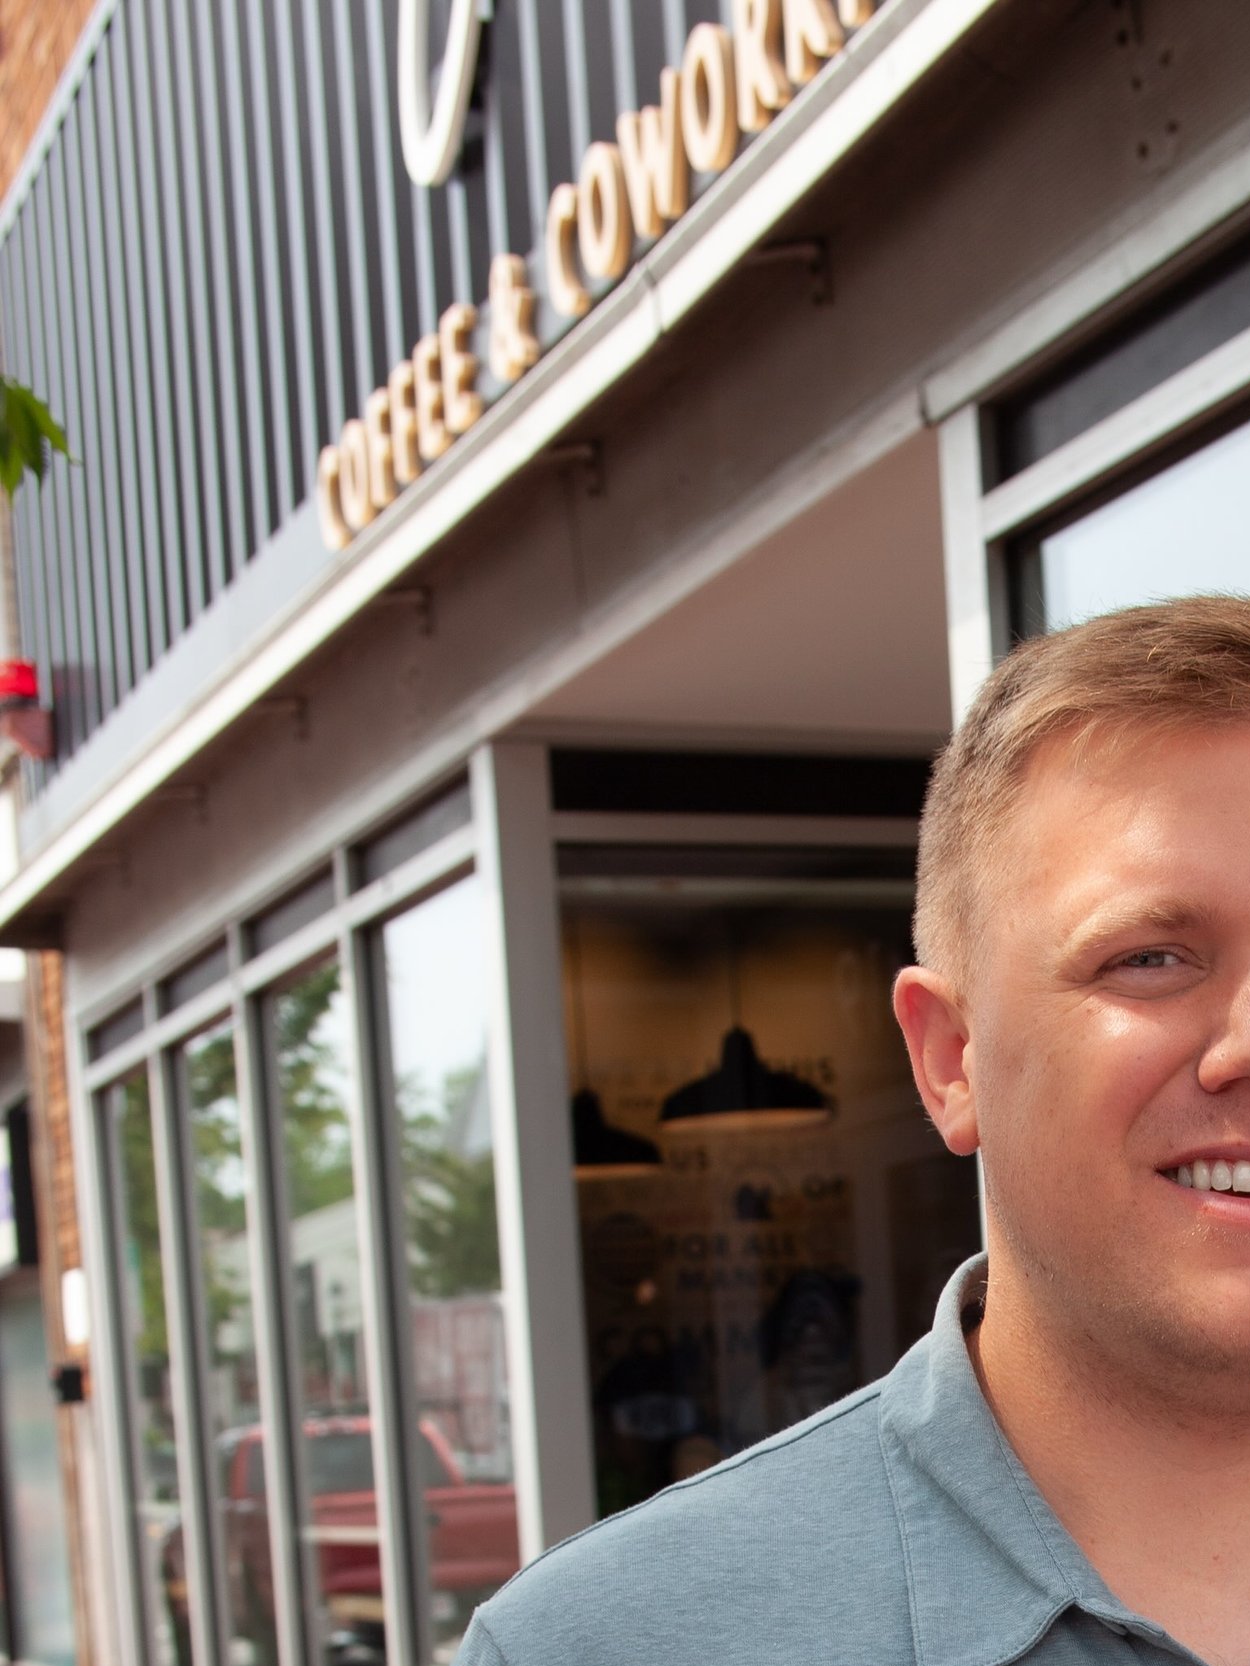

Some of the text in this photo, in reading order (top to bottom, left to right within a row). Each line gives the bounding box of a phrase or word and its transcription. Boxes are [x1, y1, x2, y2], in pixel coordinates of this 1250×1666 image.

[317, 302, 484, 550] COFFEE
[489, 253, 540, 381] &
[546, 0, 876, 316] COWORK
